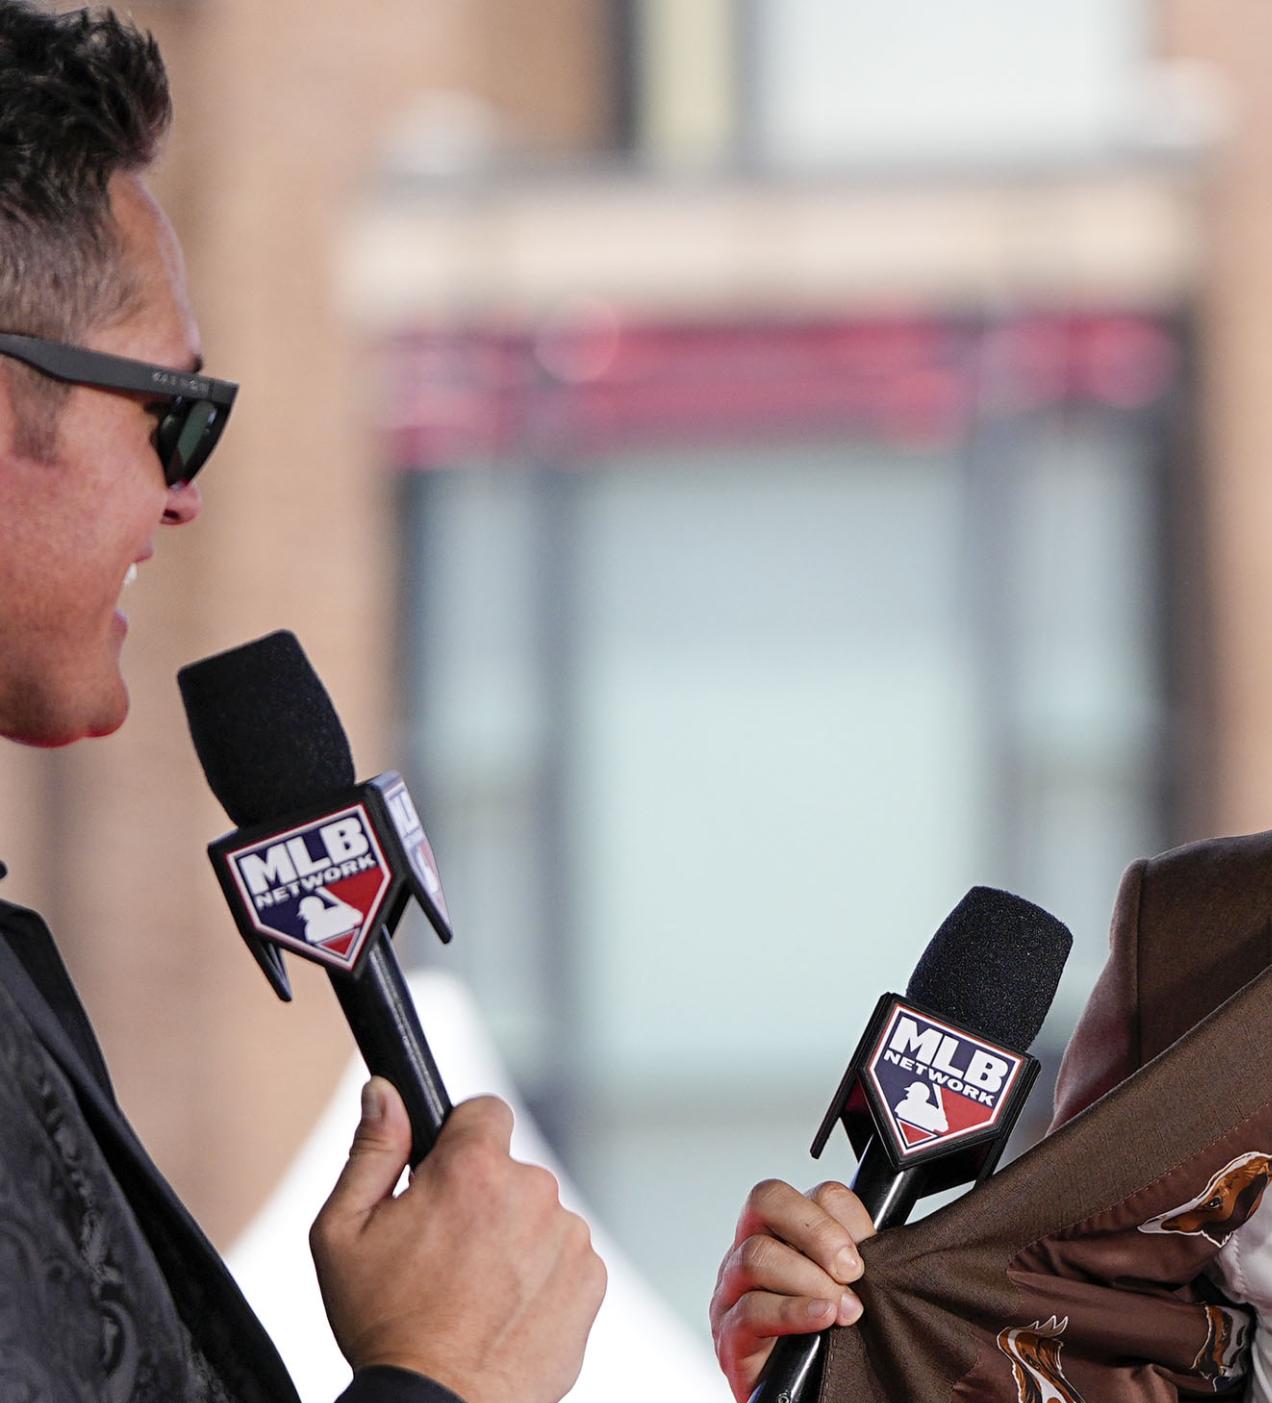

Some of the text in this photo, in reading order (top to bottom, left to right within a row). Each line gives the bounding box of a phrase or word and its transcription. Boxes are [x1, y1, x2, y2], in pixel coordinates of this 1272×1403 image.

[236, 816, 369, 896] MLB
[255, 853, 376, 911] NETWORK
[884, 1049, 995, 1107] NETWORK
[888, 1016, 1009, 1093] MLB
